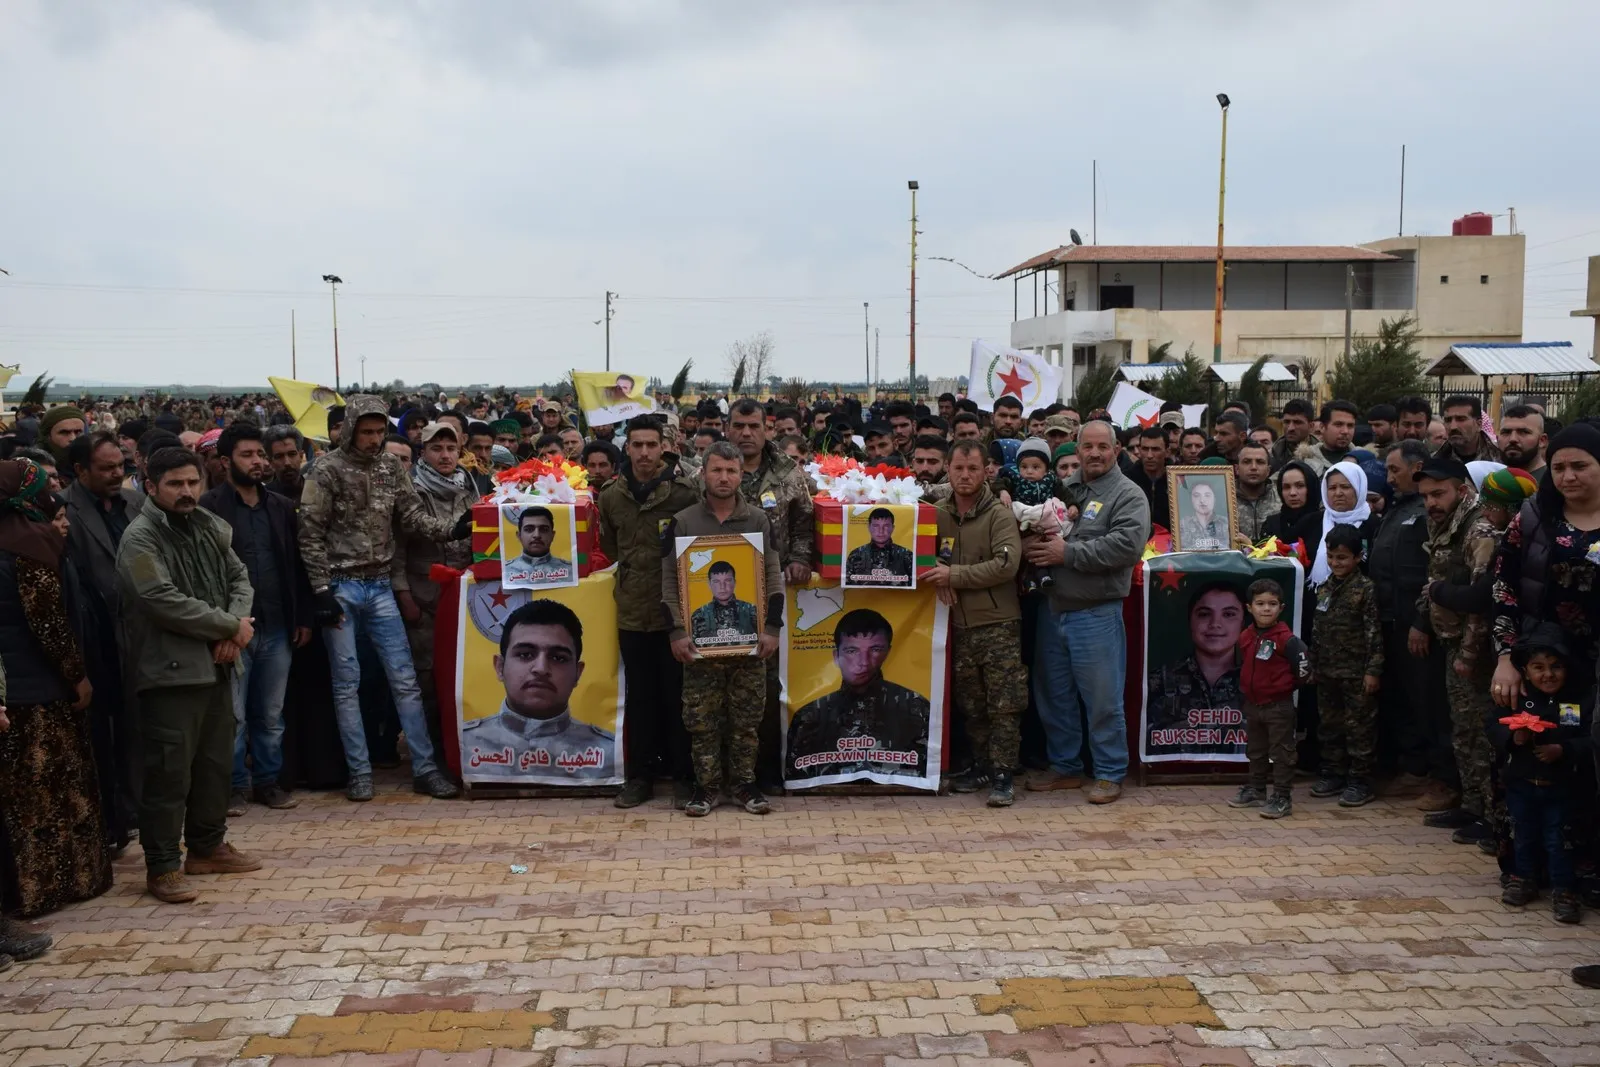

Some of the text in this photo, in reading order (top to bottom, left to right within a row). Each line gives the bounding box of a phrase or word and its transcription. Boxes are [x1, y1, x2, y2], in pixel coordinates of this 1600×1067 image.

[509, 571, 528, 581] الحسن
[546, 568, 568, 579] الشهيد
[1188, 706, 1242, 727] ŞEHÎD
[837, 735, 876, 751] ŞEHÎD
[1151, 729, 1222, 745] RUKSEN
[469, 746, 604, 772] الشهيد فادي الحسن
[795, 749, 918, 769] CEGERXWÎN HESEKÊ
